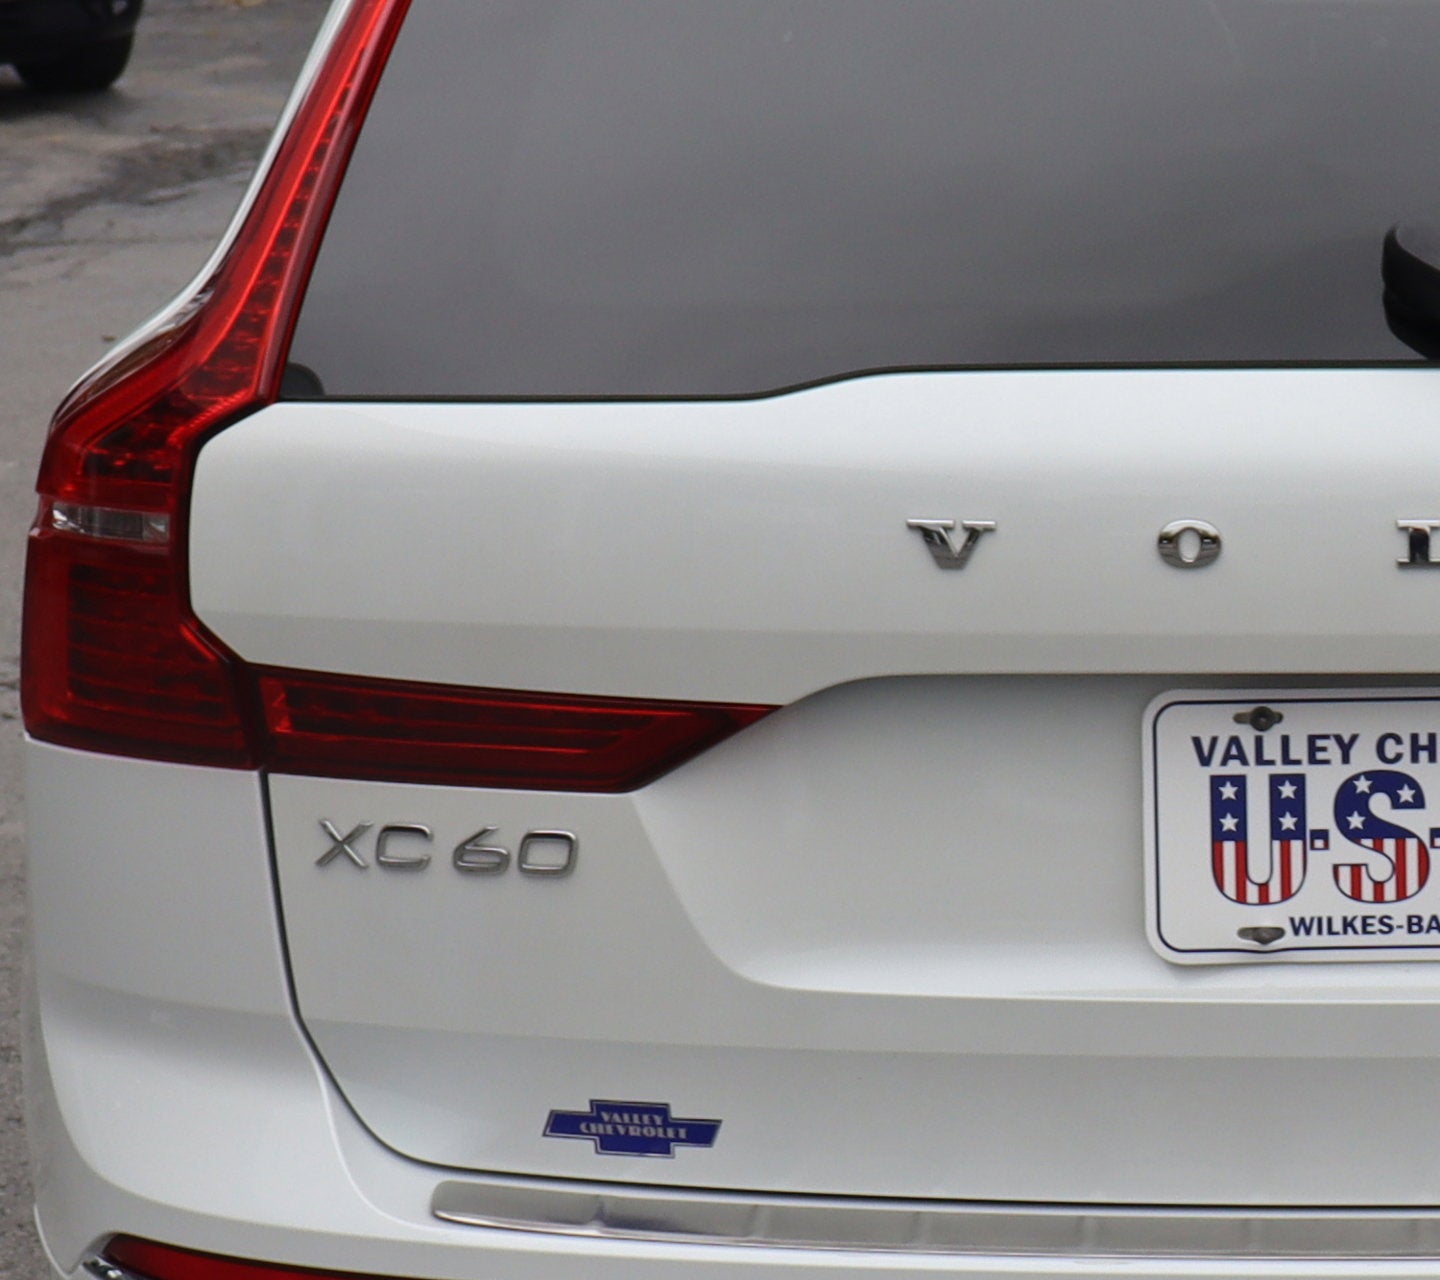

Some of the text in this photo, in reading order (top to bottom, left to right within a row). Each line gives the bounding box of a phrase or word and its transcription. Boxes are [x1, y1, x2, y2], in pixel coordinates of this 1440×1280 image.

[1191, 734, 1360, 767] VALLEY
[601, 1111, 664, 1125] VALLEY
[579, 1123, 687, 1139] CHEVROLET
